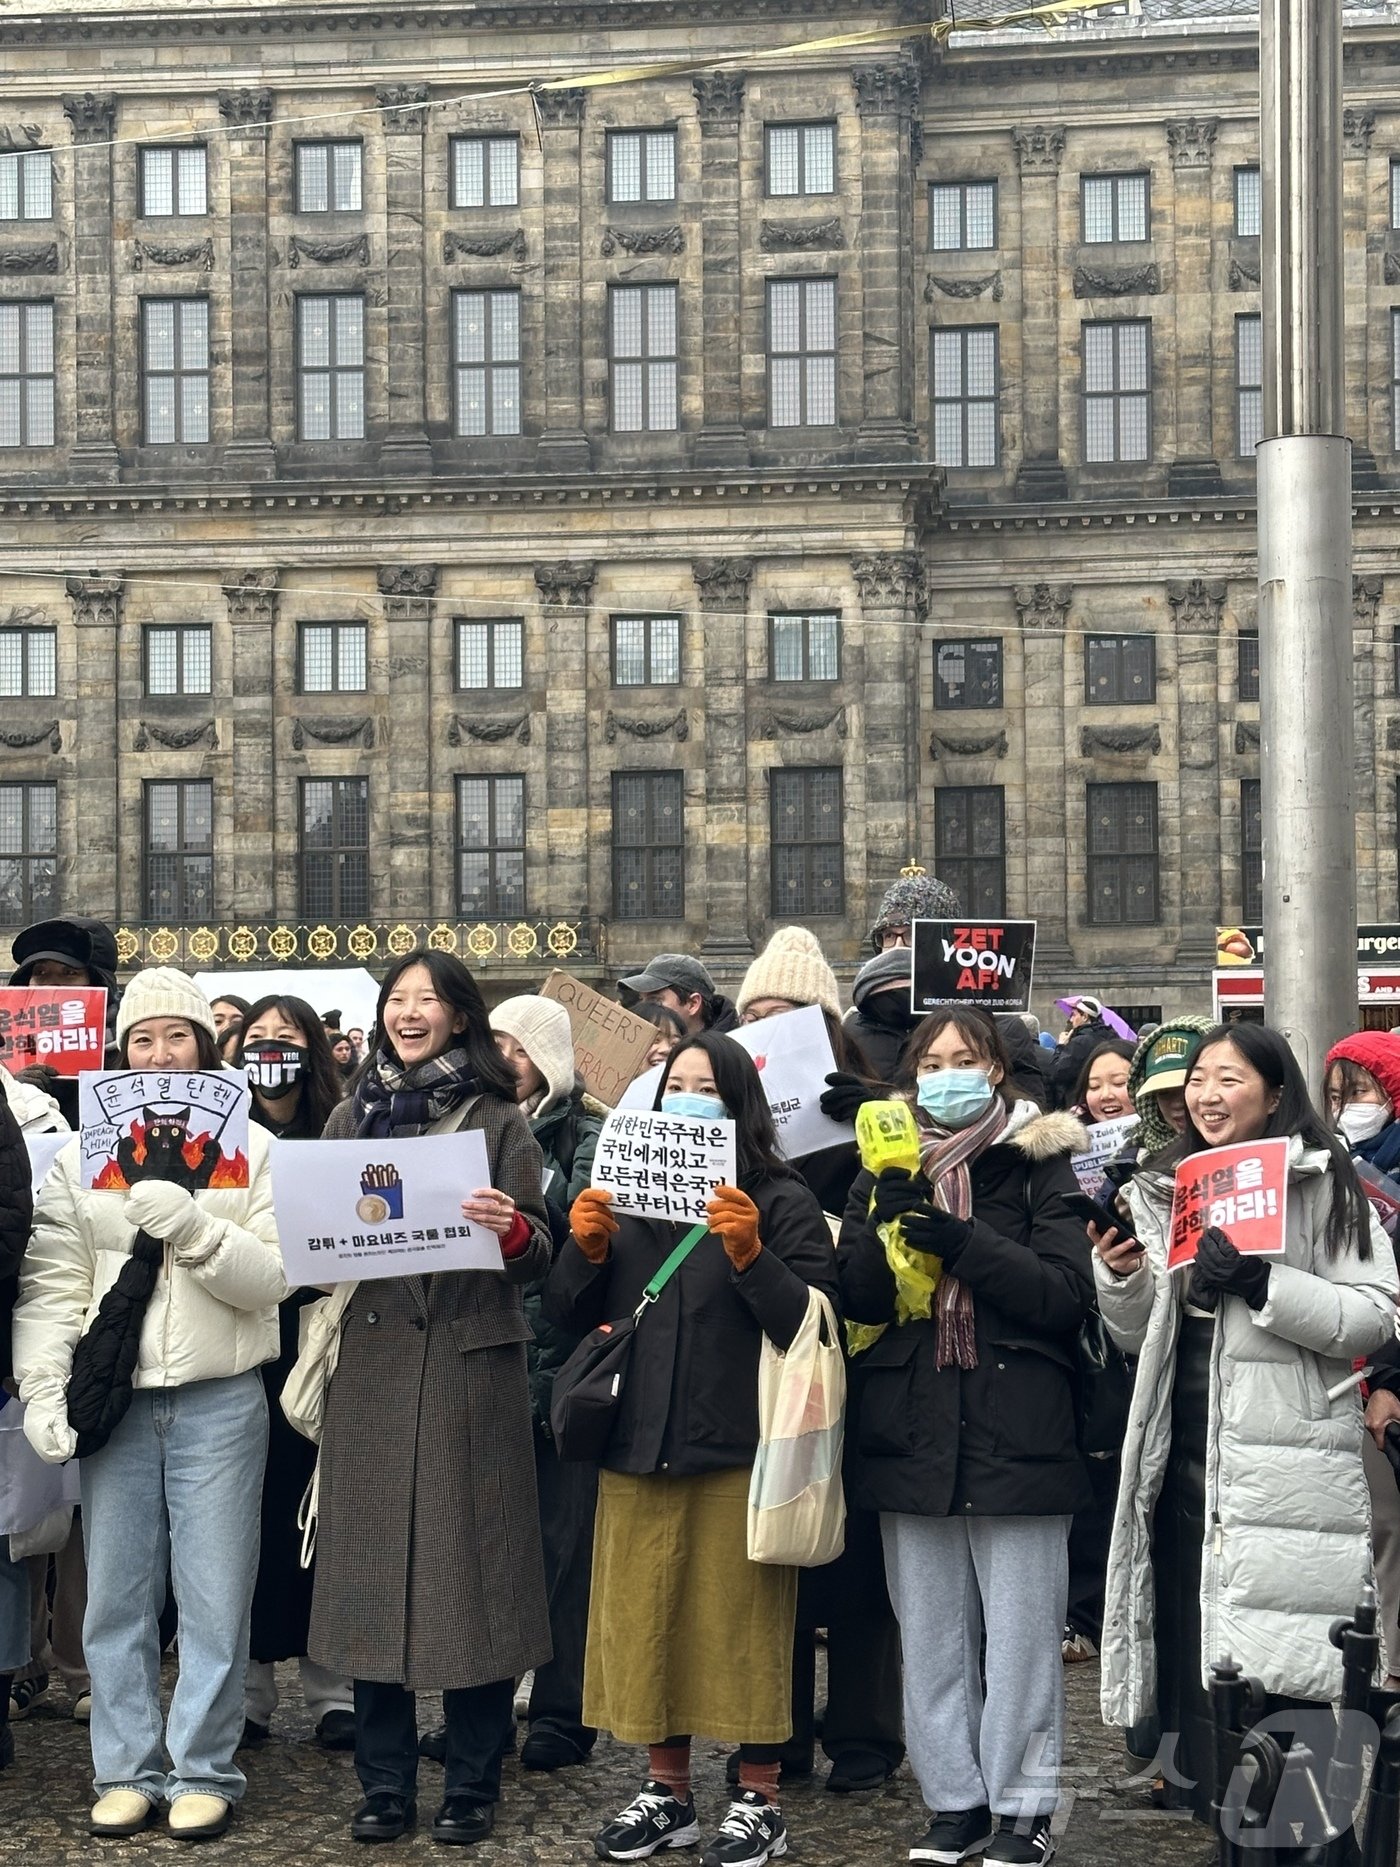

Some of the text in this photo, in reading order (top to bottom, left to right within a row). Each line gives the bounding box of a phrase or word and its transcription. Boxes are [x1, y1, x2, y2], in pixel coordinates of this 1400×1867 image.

[953, 928, 1004, 950] ZET
[1356, 936, 1400, 954] urge
[941, 938, 1016, 978] YOON
[956, 968, 999, 990] AF!
[557, 982, 643, 1044] QUEERS
[243, 1062, 302, 1088] OUT
[84, 1126, 115, 1141] IMPEACH
[90, 1139, 112, 1150] HIM!
[610, 1115, 728, 1148] 대한민국주권은
[602, 1139, 709, 1170] 국민에게있고
[1174, 1158, 1264, 1216] 윤석열을
[608, 1192, 708, 1218] 로부터나온
[1173, 1188, 1278, 1249] 탄핵하라!
[308, 1237, 335, 1251] 감튀
[353, 1231, 408, 1248] 마요네즈
[444, 1226, 471, 1240] 협회
